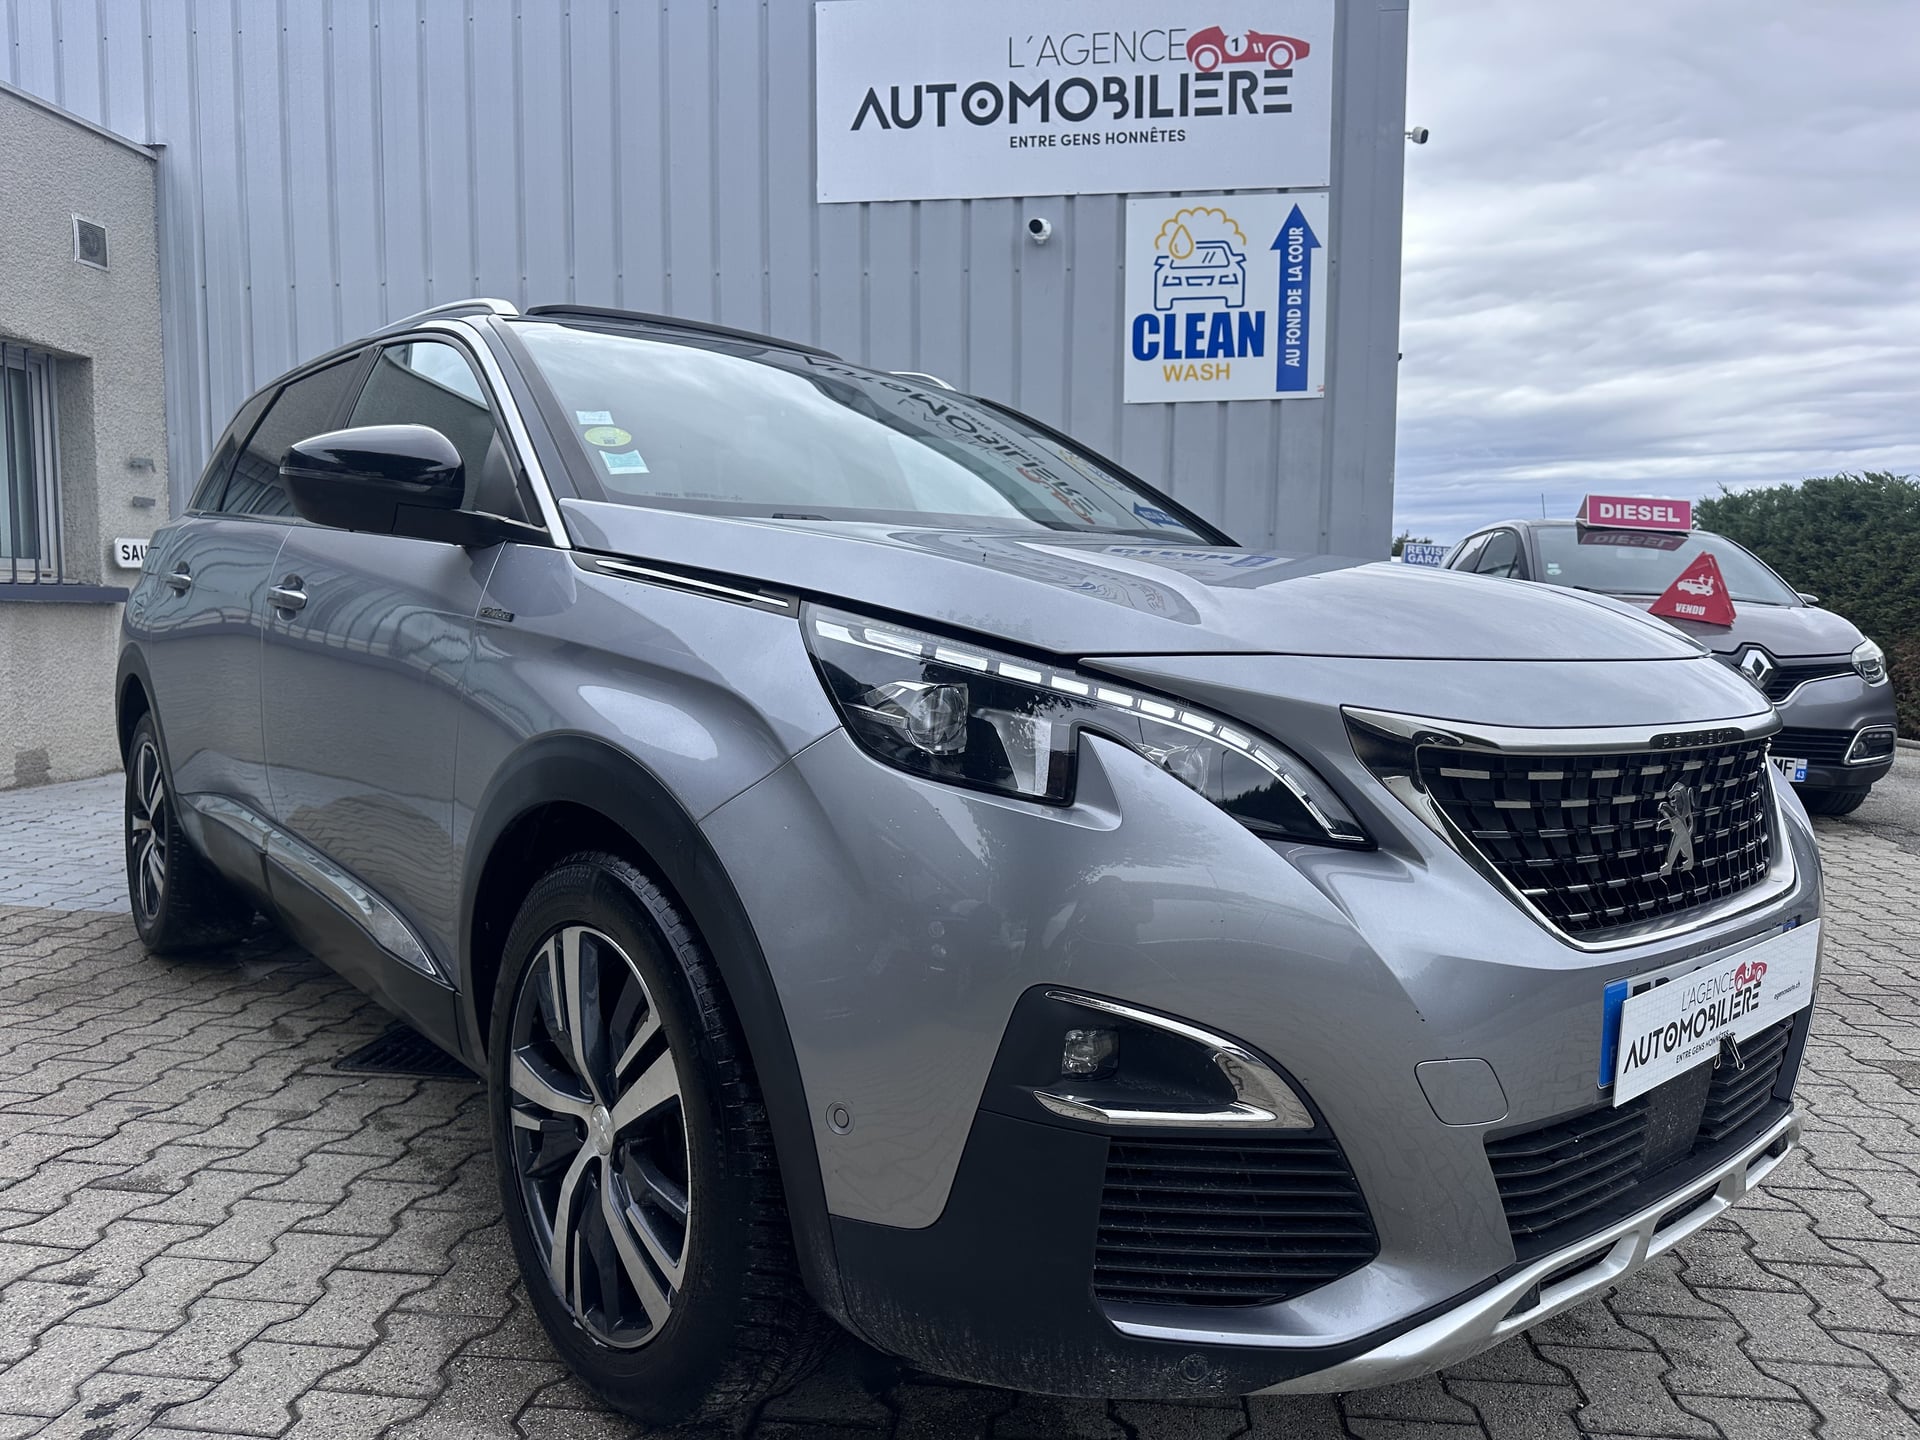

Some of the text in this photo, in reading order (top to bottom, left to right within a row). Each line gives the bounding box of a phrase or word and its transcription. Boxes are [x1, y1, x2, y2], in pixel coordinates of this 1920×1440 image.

[1008, 28, 1187, 68] L'AGENCE
[1231, 37, 1240, 53] 1
[1009, 127, 1186, 149] ENTRE GENS HONNÊTES
[1285, 226, 1304, 367] AU FOND DE LA COUR
[1132, 310, 1266, 361] CLEAN
[1162, 362, 1231, 382] WASH
[1599, 503, 1681, 523] DIESEL
[1675, 602, 1706, 616] VENDU
[1681, 968, 1736, 1012] L'AGENCE
